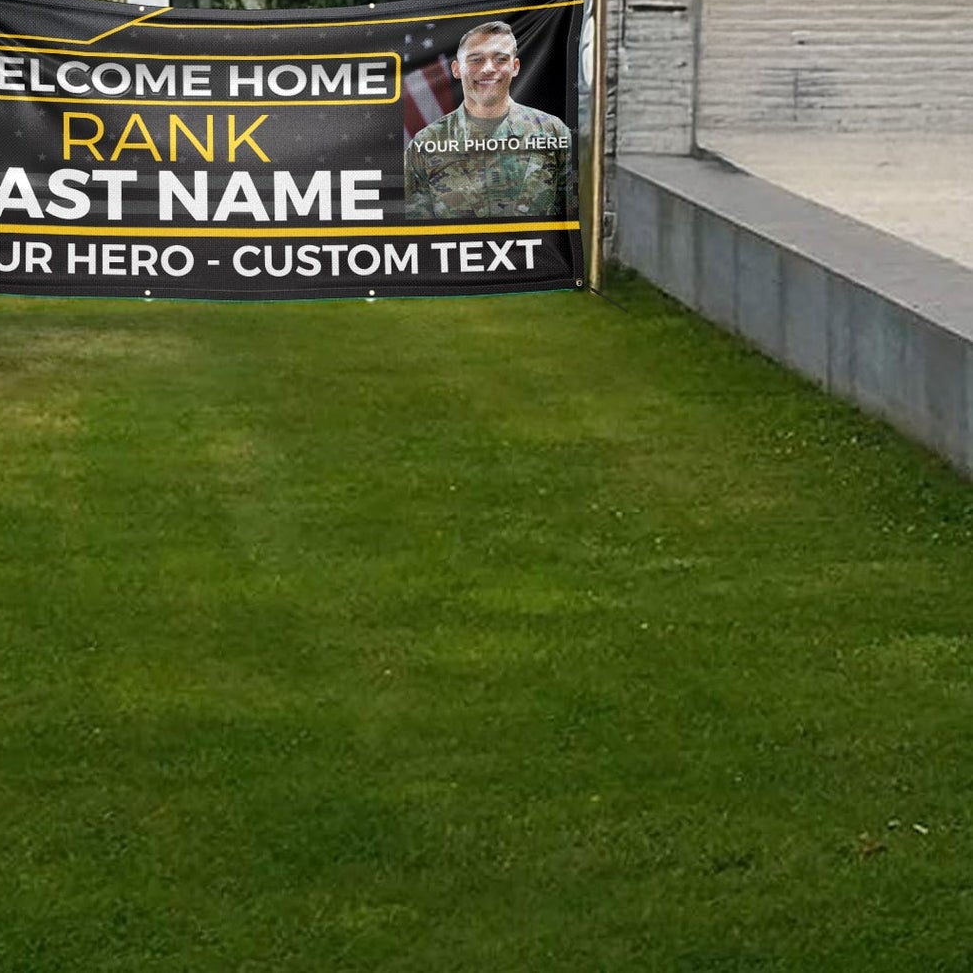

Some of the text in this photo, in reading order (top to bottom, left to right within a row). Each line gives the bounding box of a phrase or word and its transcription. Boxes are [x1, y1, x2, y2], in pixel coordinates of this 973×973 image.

[230, 63, 387, 97] HOME
[63, 113, 270, 162] RANK
[415, 137, 568, 152] YOUR PHOTO HERE
[160, 170, 383, 221] NAME
[66, 243, 194, 276] HERO
[233, 243, 416, 276] CUSTOM
[431, 239, 541, 272] TEXT
